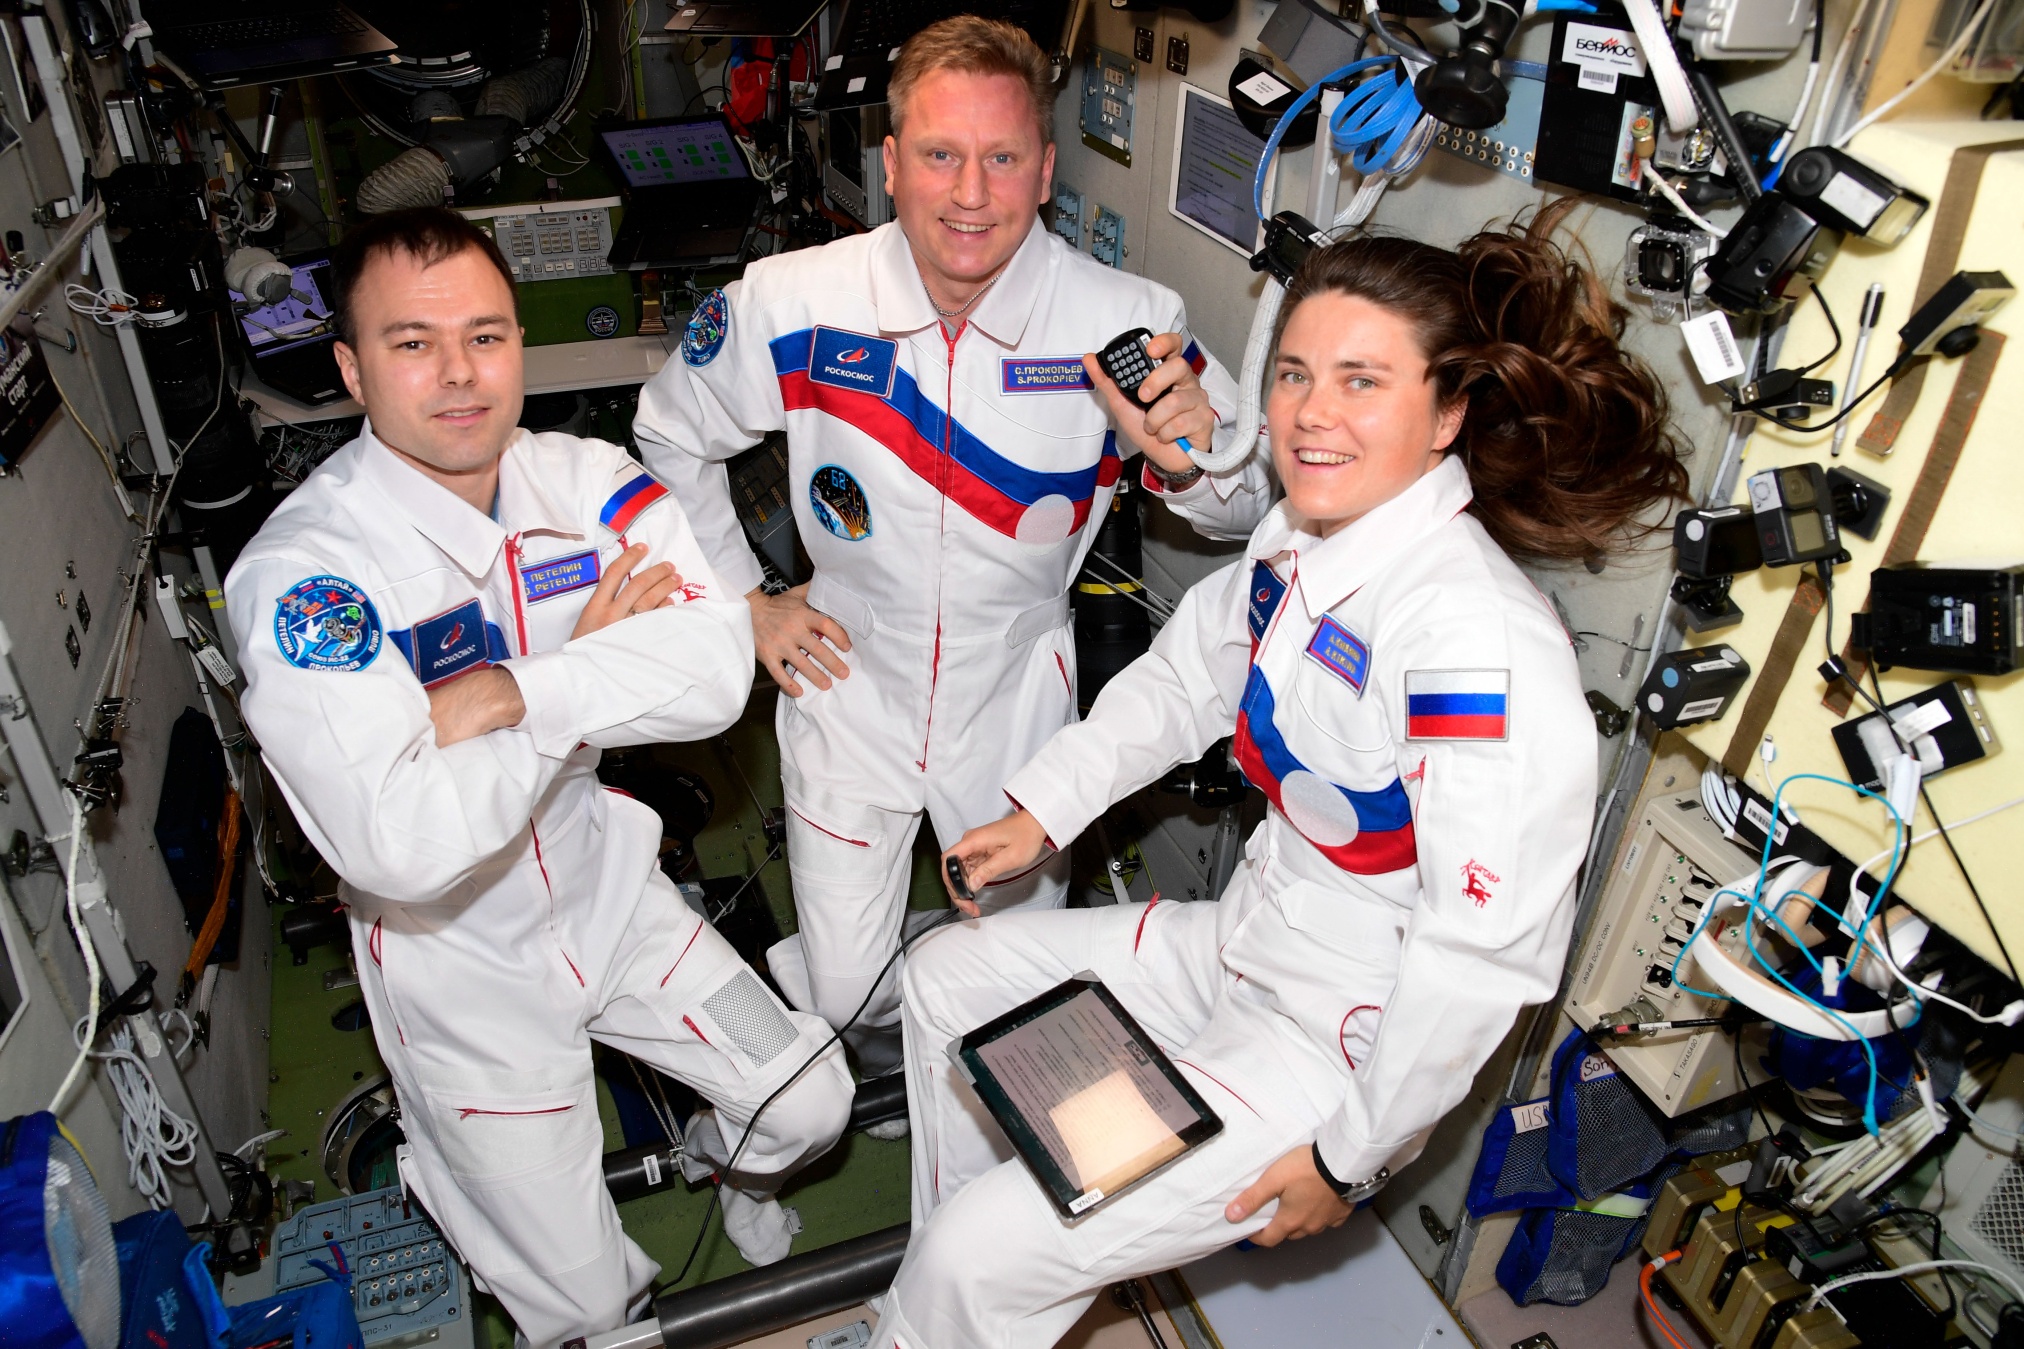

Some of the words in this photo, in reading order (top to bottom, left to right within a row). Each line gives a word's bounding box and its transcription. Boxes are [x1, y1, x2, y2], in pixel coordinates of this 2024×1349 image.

[824, 366, 875, 382] РОСКОСМОС
[1015, 365, 1083, 375] С.ПРОКОПЬЕВ
[1017, 374, 1081, 384] S.PROKOPIEV
[8, 375, 28, 405] старт
[831, 469, 846, 490] 68
[278, 616, 295, 655] ПЕТЕЛИН
[368, 629, 380, 653] RUBIO
[308, 660, 361, 673] ПРОКОПЬЕВ
[433, 644, 476, 669] РОСКОСМОС
[1591, 940, 1603, 961] DC/DC
[1601, 922, 1611, 940] CONV
[1680, 1038, 1698, 1070] TAKASAGO
[1076, 1191, 1099, 1208] ANNA
